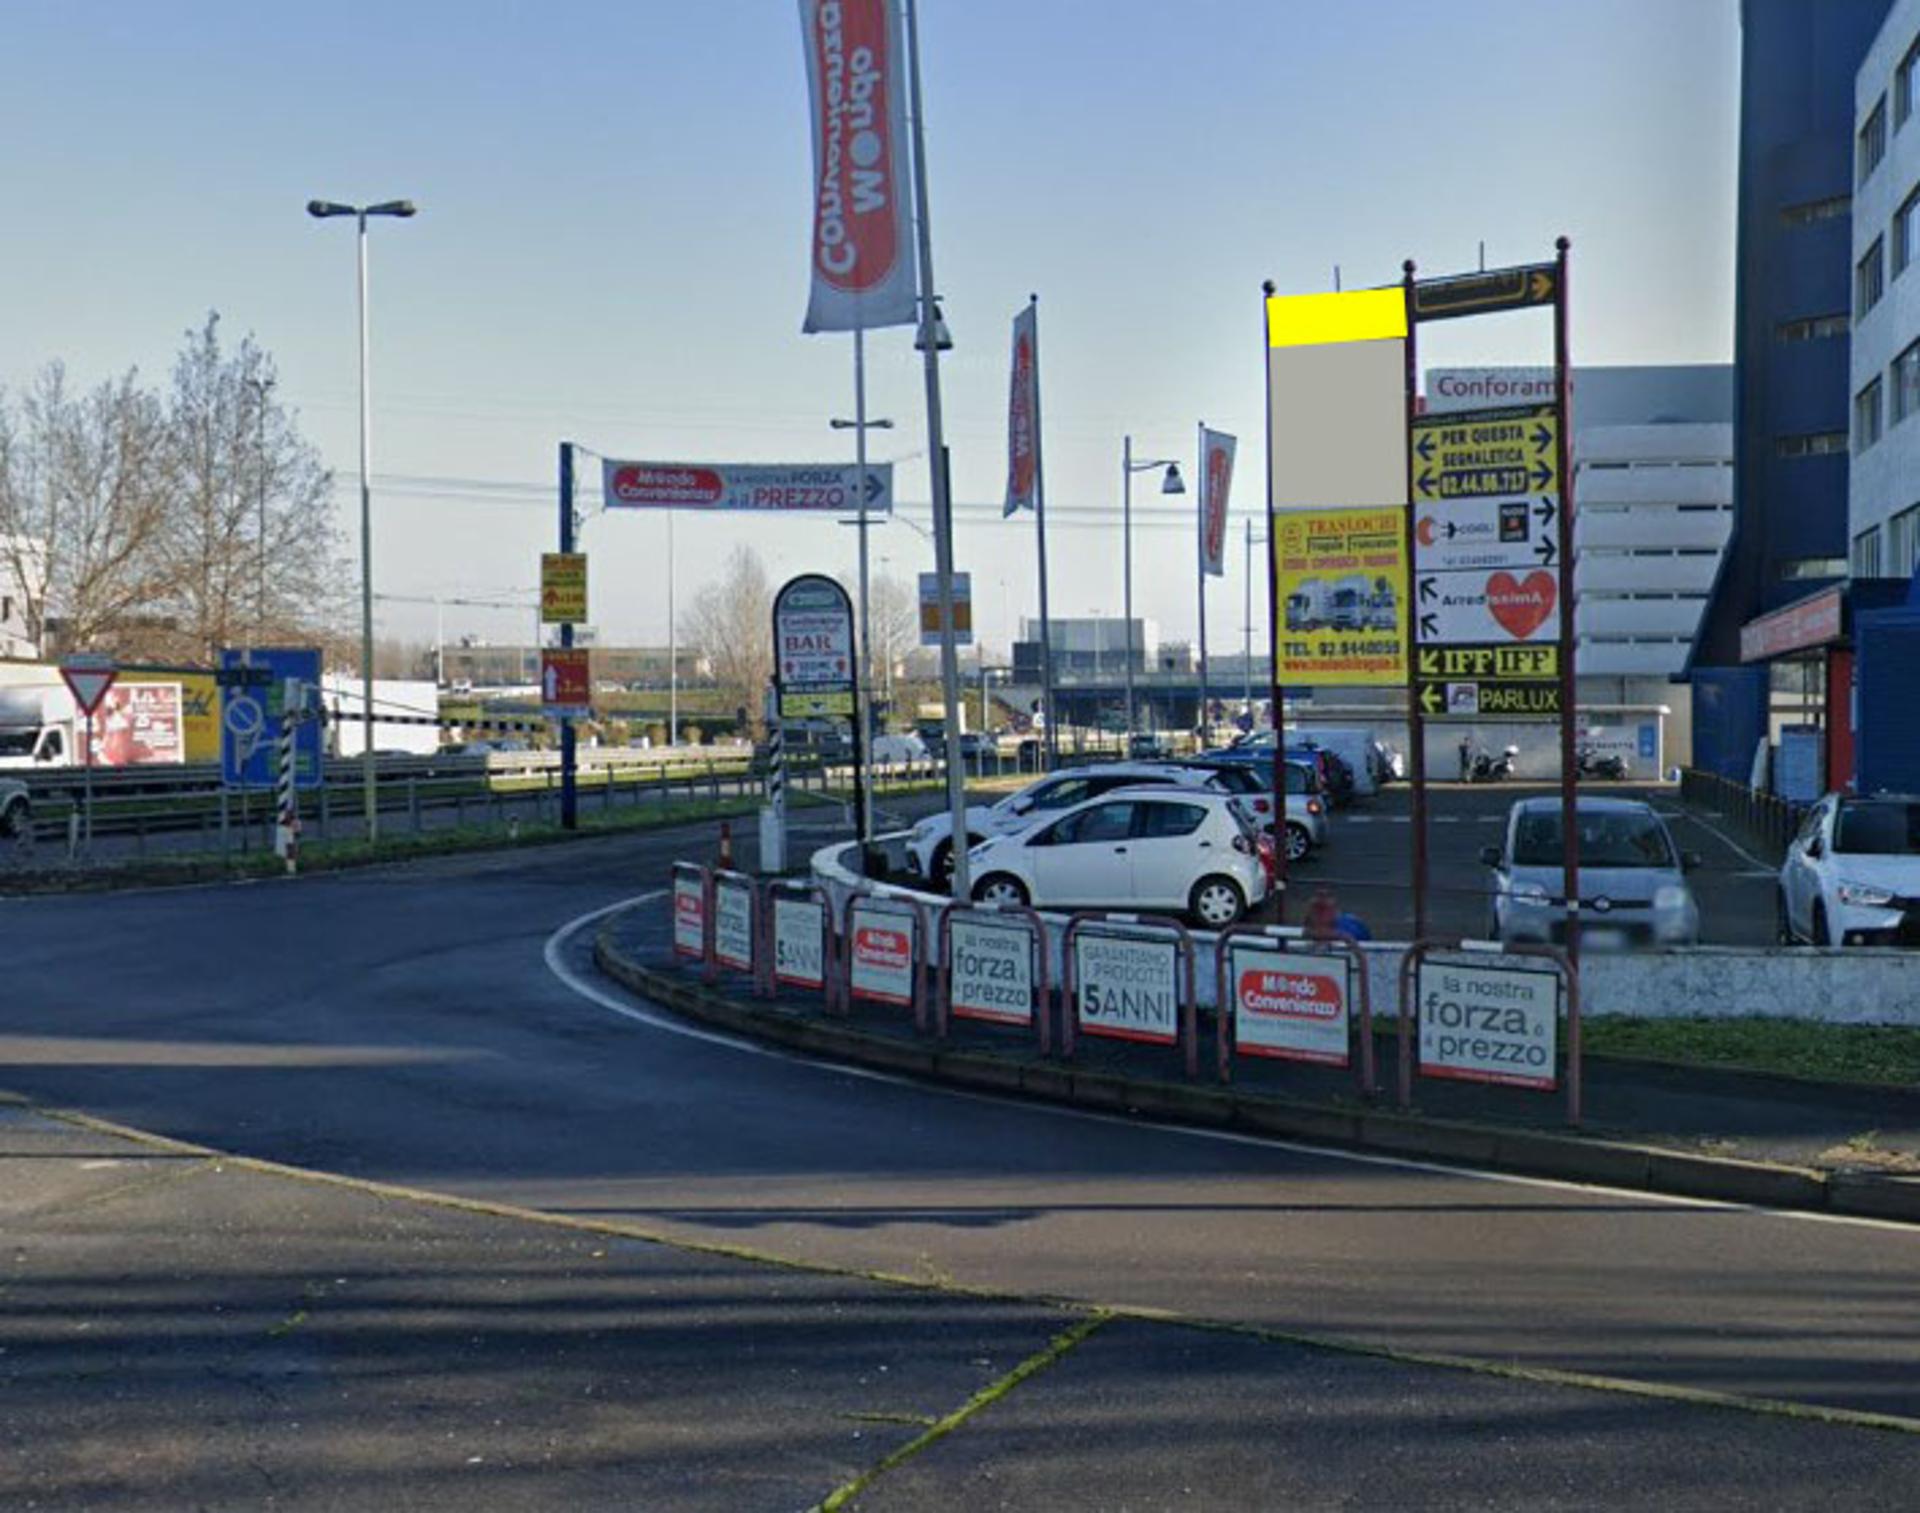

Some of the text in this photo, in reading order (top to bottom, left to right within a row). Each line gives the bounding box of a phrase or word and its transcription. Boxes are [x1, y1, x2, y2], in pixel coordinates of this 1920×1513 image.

[1441, 426, 1524, 446] PER QUESTA
[753, 488, 844, 508] PREZZO
[785, 635, 832, 650] BAR
[1480, 688, 1559, 710] PARLUX
[955, 948, 1017, 982] forza
[962, 980, 1028, 1007] prezzo
[1443, 975, 1534, 1000] la nostra
[1425, 992, 1528, 1035] forza
[1439, 1035, 1546, 1066] prezzo
